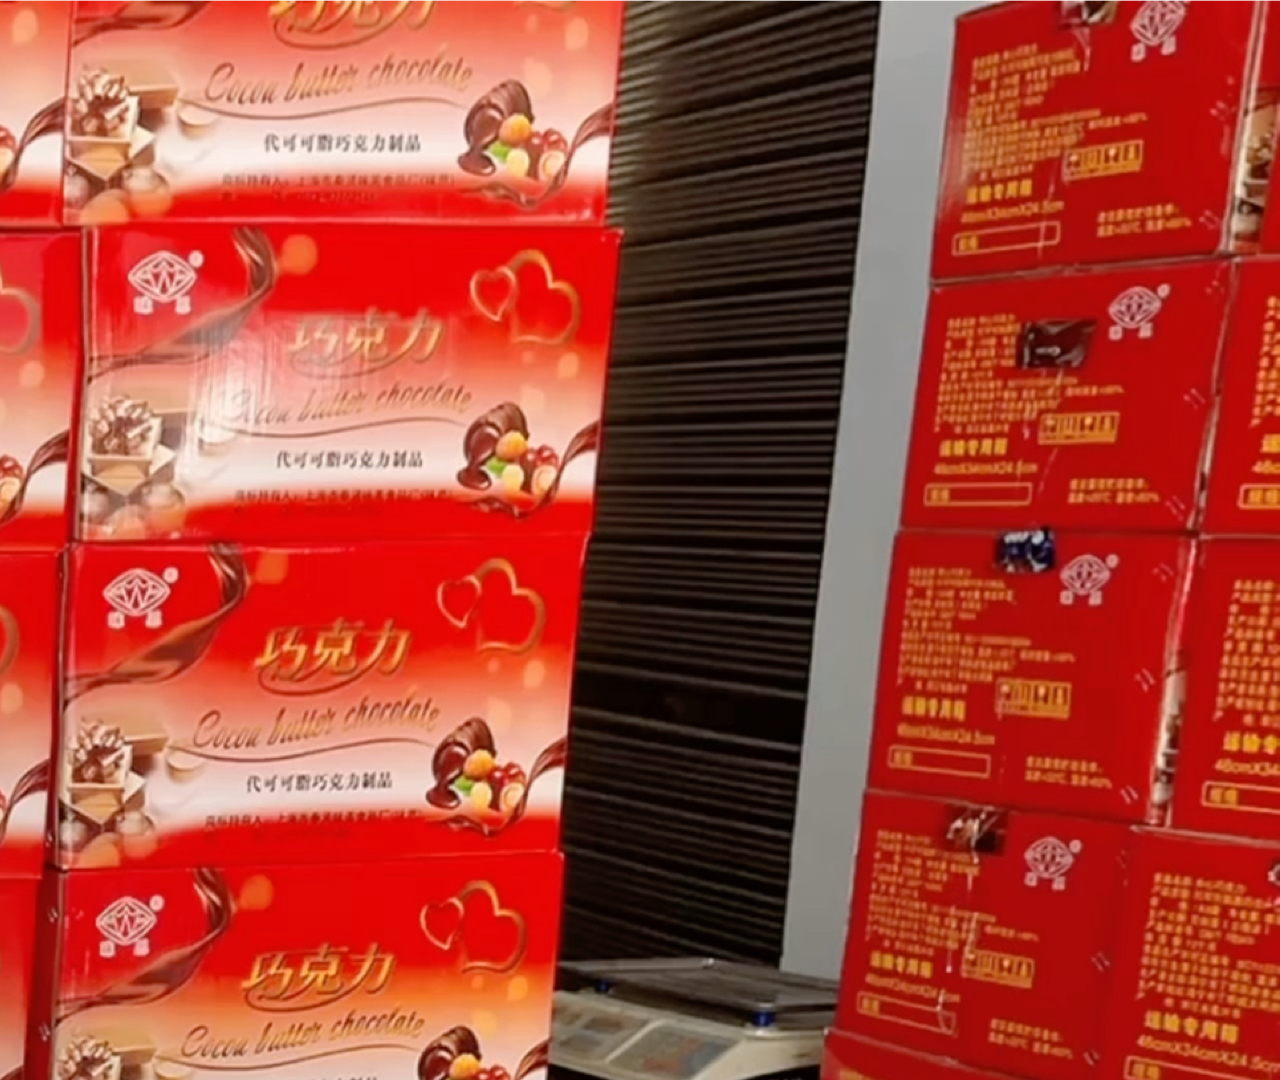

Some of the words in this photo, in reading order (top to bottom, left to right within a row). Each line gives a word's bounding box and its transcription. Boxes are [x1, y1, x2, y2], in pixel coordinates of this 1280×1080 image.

[206, 61, 276, 105] Cocoa
[286, 64, 358, 103] butter
[368, 50, 473, 91] chocolate
[264, 134, 421, 153] 代可可脂巧克力制品
[289, 306, 445, 363] 巧克力
[373, 378, 473, 413] chocolate
[276, 451, 423, 470] 代可可脂巧克力制品
[256, 619, 412, 680] 巧克力
[193, 710, 260, 750] Cocoa
[266, 707, 337, 749] butter
[343, 696, 440, 731] chocolate
[246, 772, 393, 793] 代可可脂巧克力制品
[243, 944, 395, 1003] 巧克力
[182, 1022, 248, 1058] Cocoa
[256, 1019, 324, 1056] butter
[329, 1008, 426, 1038] chocolate
